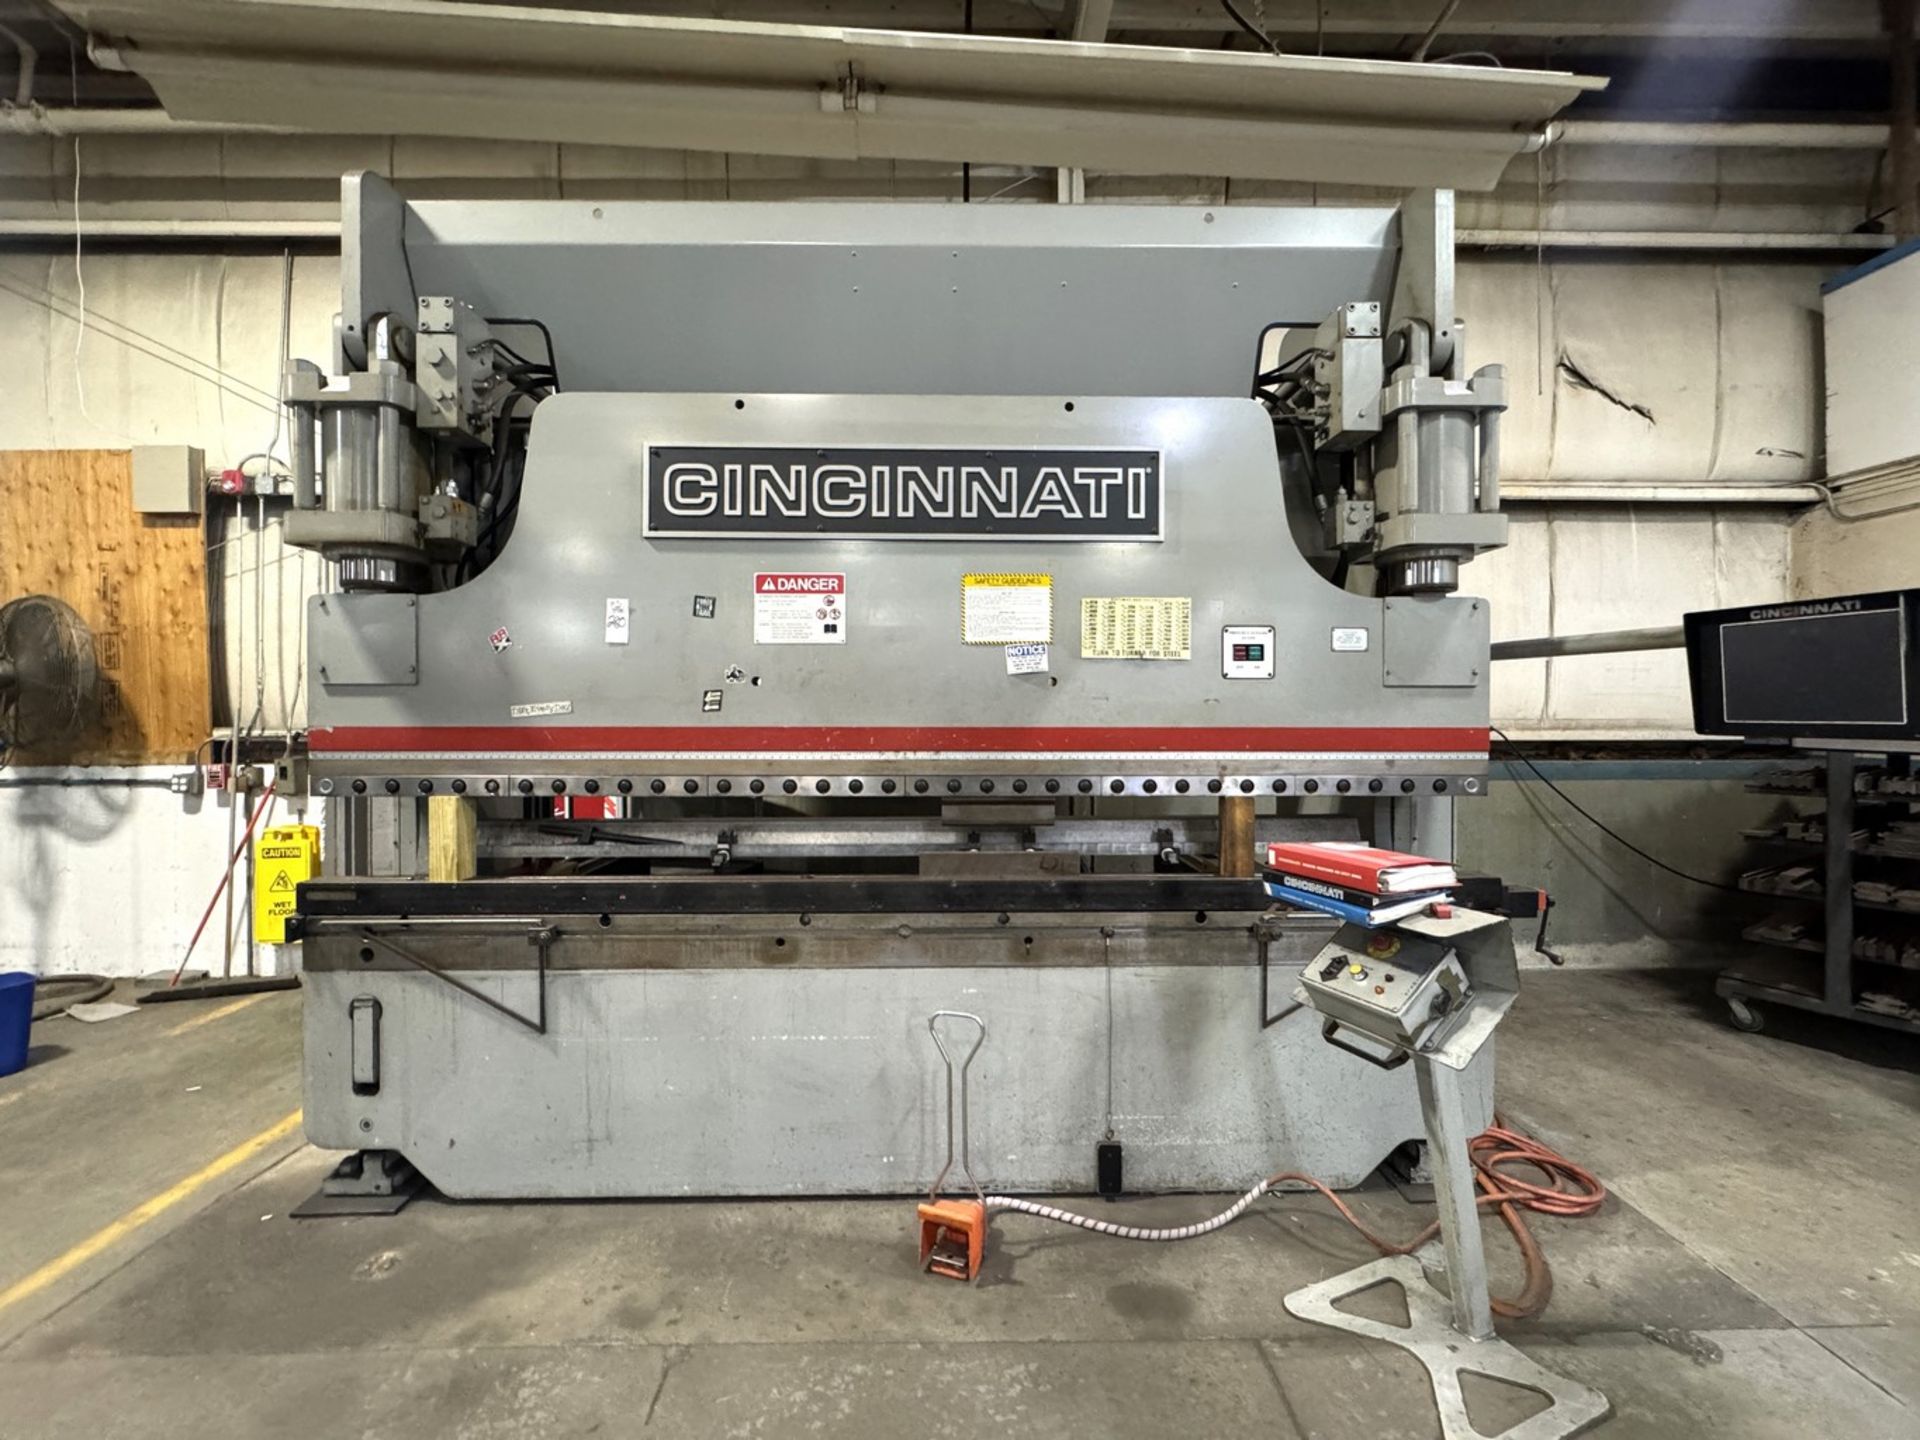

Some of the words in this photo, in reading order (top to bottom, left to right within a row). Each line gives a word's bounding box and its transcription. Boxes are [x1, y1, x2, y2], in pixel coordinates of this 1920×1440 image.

[663, 463, 1146, 519] CINCINNATI
[777, 578, 838, 591] DANGER
[1750, 600, 1861, 620] CINCINNATI
[1007, 645, 1045, 656] NOTICE
[263, 848, 301, 857] CAUTION
[1283, 876, 1344, 900] CINCINNATI
